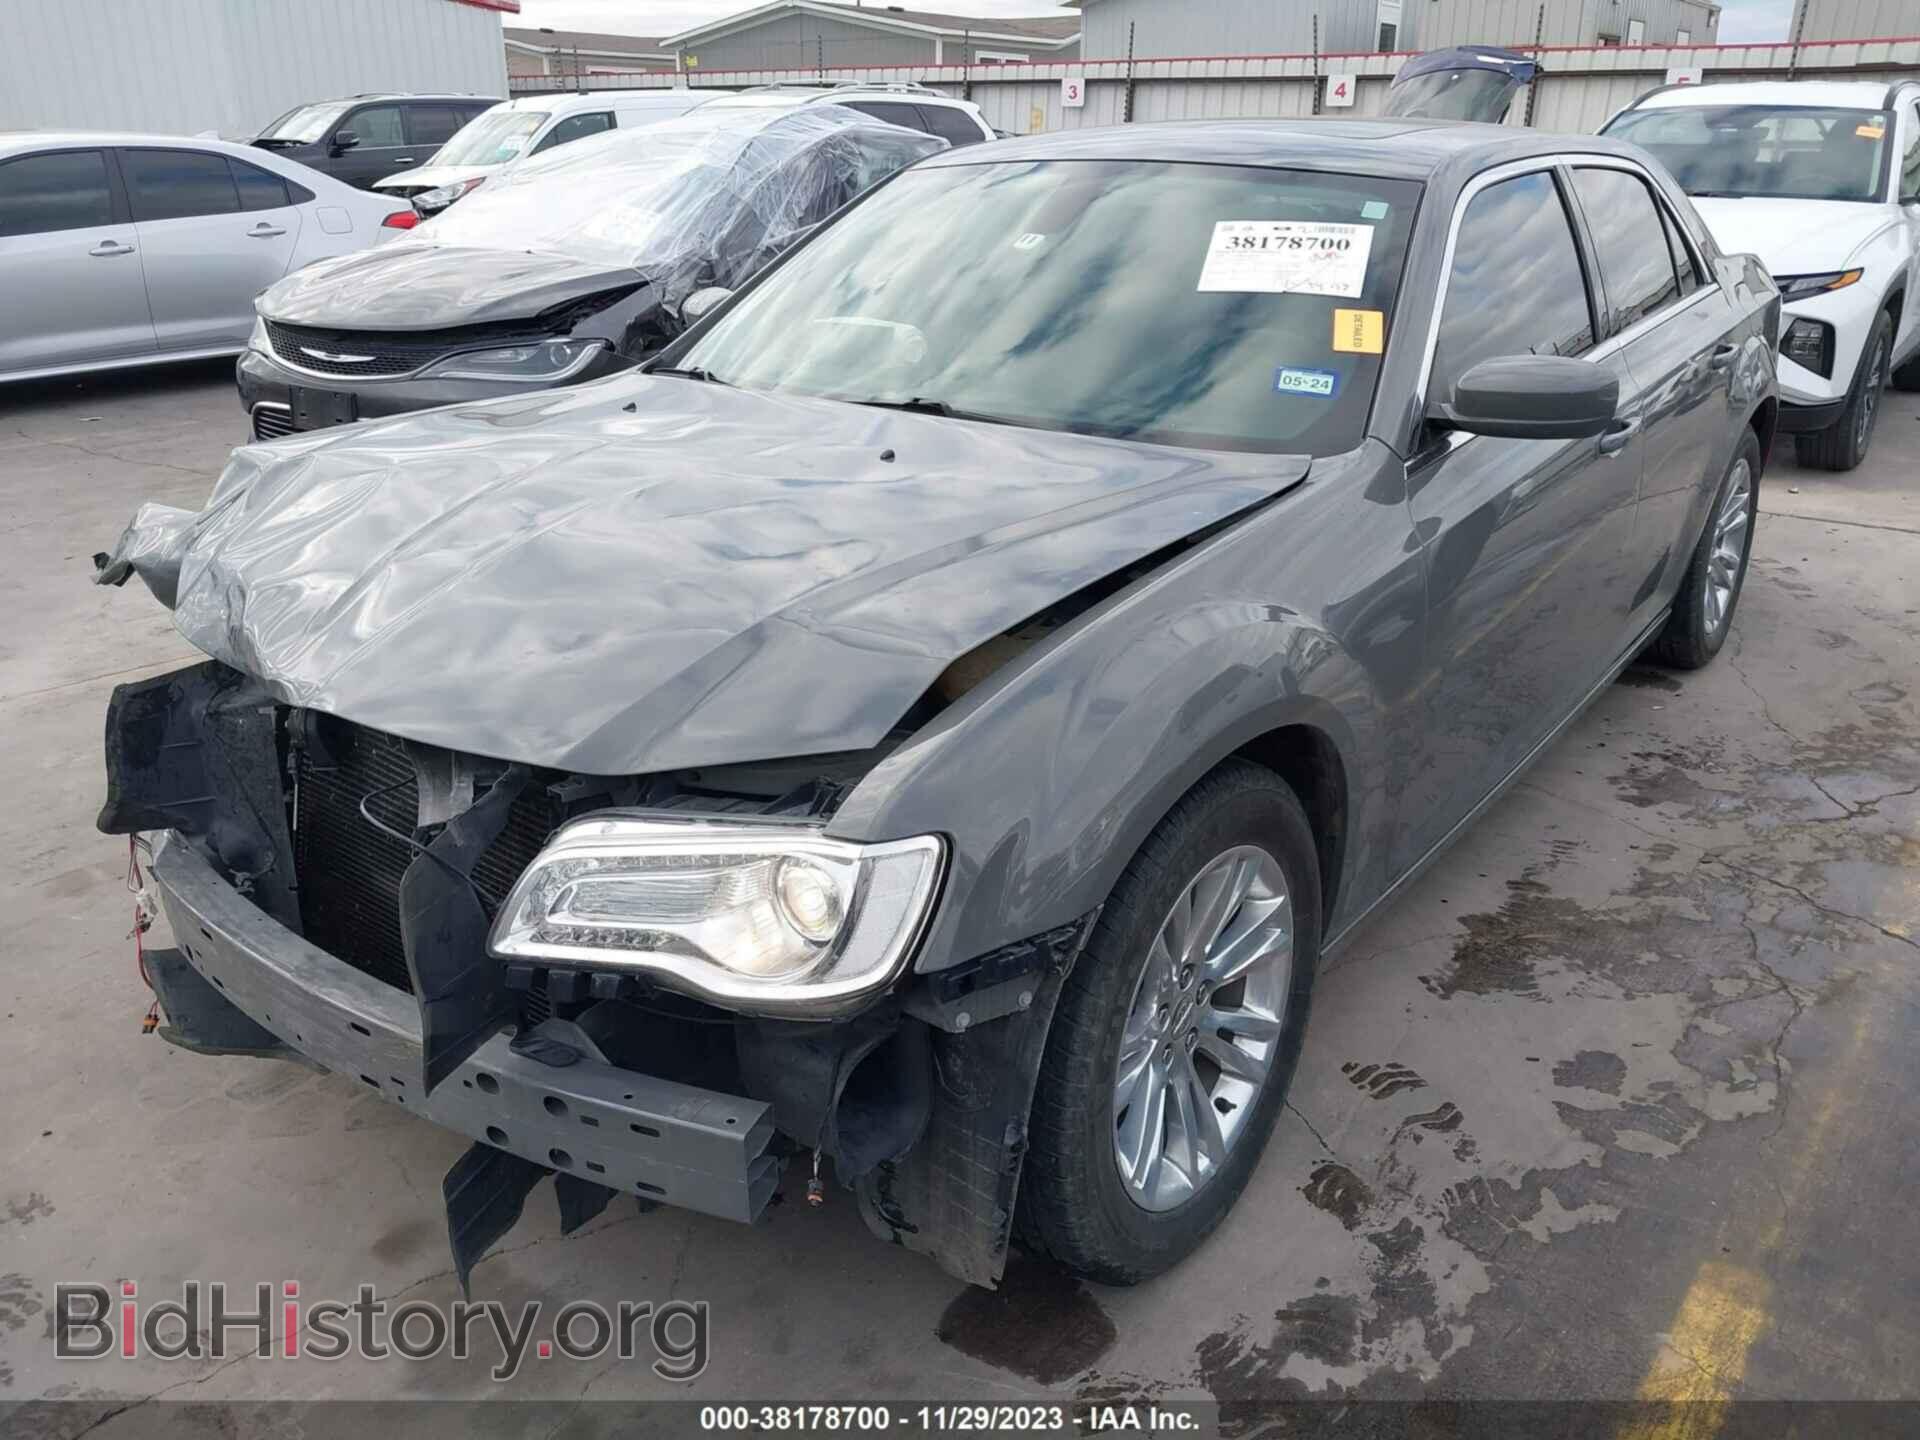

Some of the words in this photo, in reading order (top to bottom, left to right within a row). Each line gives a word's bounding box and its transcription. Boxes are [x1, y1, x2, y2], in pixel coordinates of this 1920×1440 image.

[1068, 85, 1078, 99] 3
[1335, 82, 1346, 98] 4
[1225, 236, 1352, 251] 38178700
